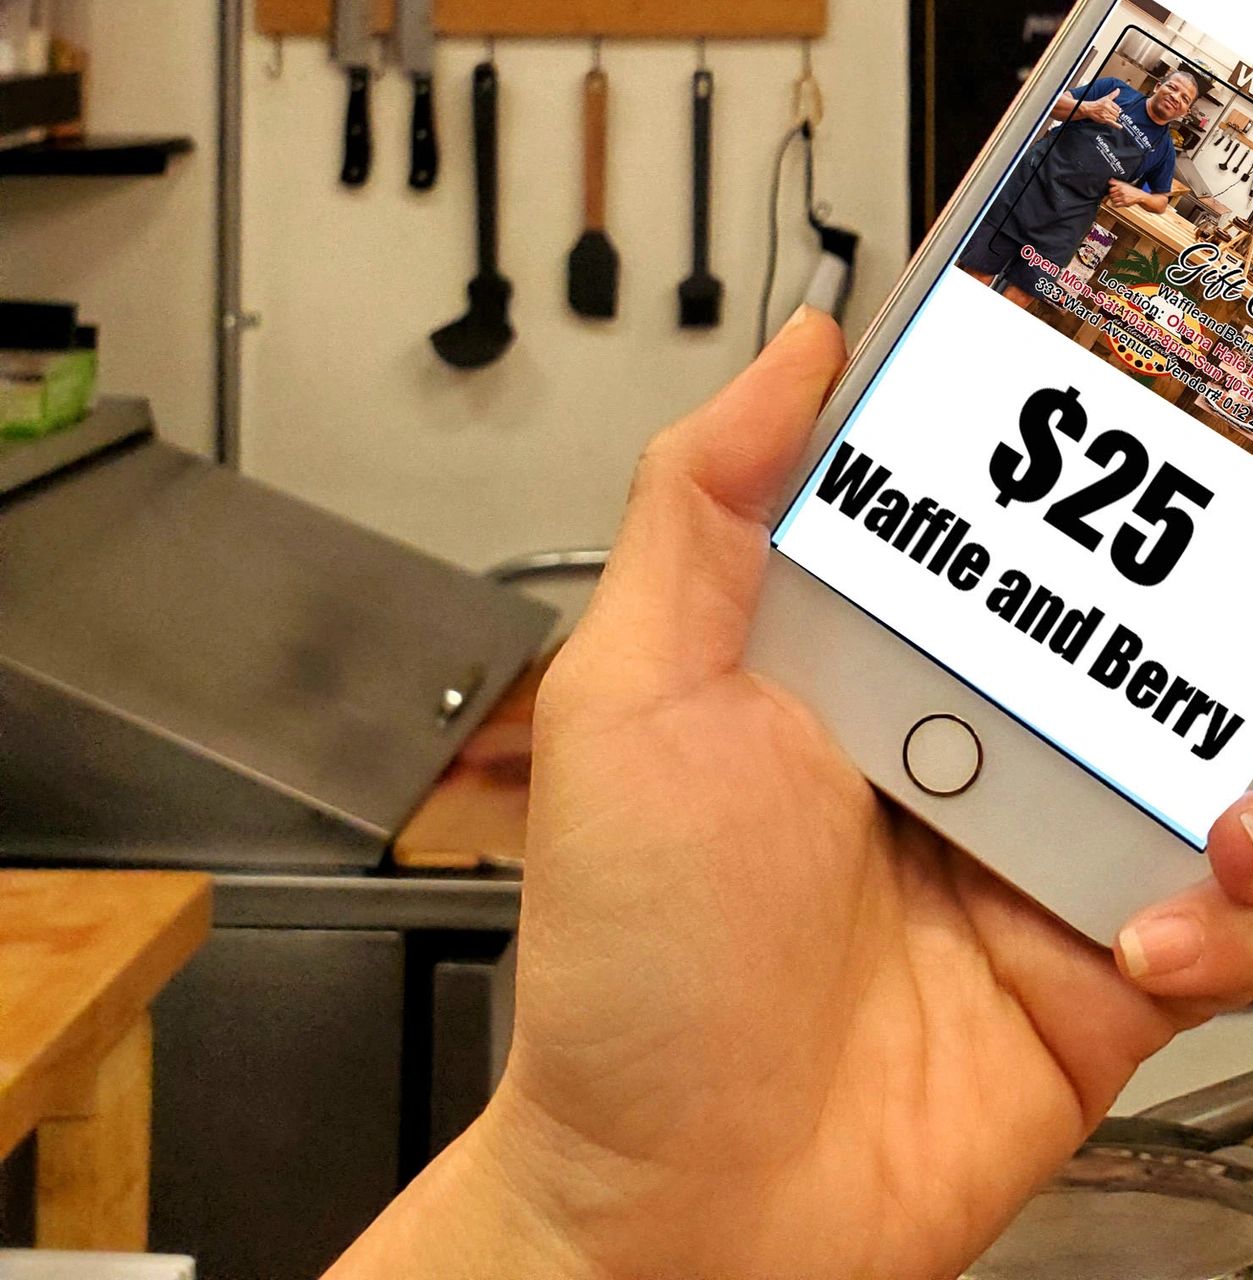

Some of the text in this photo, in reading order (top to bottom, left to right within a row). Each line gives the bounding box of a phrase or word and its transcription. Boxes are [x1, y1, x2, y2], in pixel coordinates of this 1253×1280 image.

[1020, 245, 1060, 277] Open
[1061, 269, 1119, 316] Mon-Sat
[1121, 309, 1193, 363] 10am-8pm
[1194, 352, 1223, 382] Sun
[1099, 271, 1166, 320] Location:
[1166, 314, 1213, 352] Ohana
[1213, 342, 1249, 372] Hale
[1167, 243, 1247, 300] Gift
[1035, 277, 1063, 303] 333
[1063, 293, 1102, 327] Ward
[1100, 320, 1154, 360] Avenue
[1164, 357, 1223, 403] Vendor#
[1222, 395, 1251, 422] 012
[988, 385, 1216, 587] $25
[815, 440, 1246, 761] Waffle and Berry
